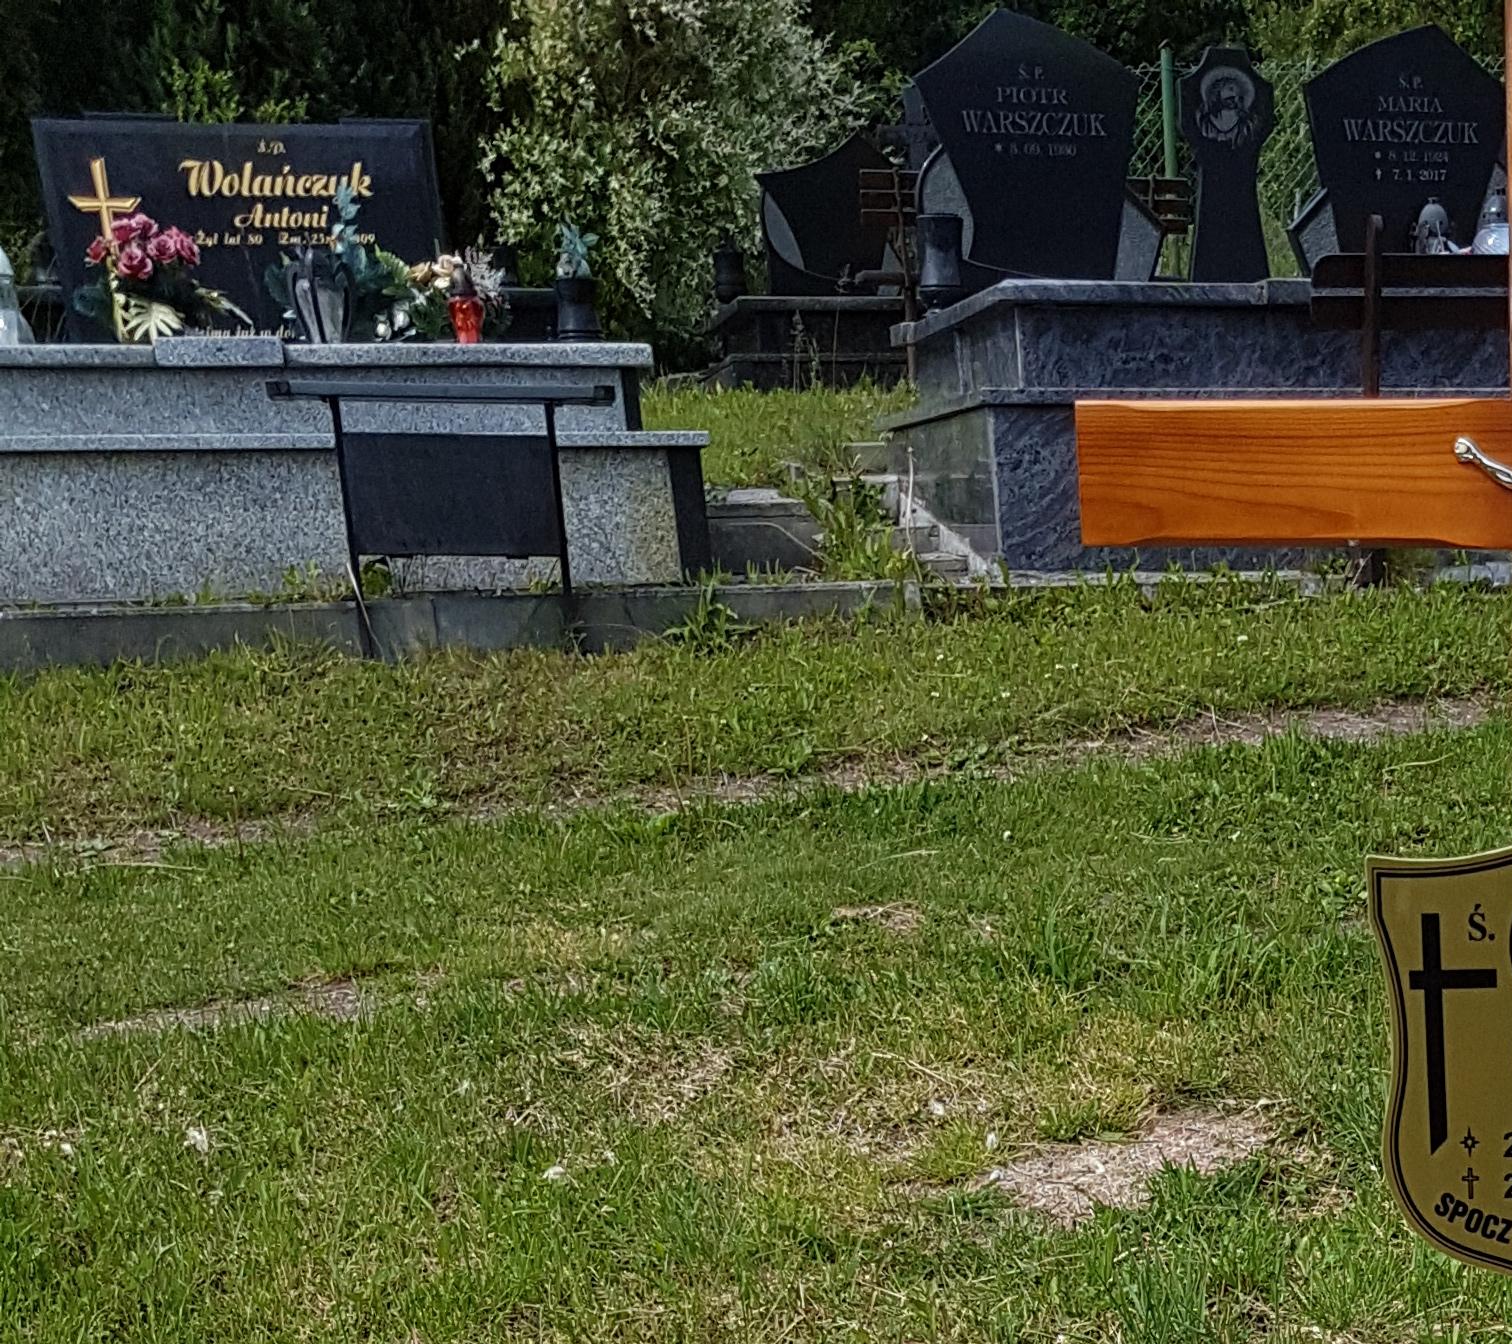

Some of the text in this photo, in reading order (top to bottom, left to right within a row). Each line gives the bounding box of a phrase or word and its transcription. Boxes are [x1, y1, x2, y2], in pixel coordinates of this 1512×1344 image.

[996, 86, 1068, 104] PIOTR
[1378, 95, 1443, 112] MARIA
[962, 110, 1107, 136] WARSZCZUK
[1343, 118, 1479, 144] WARSZCZUK
[1419, 168, 1447, 181] 2017
[234, 202, 328, 228] Antoni
[1467, 903, 1496, 942] Ś.
